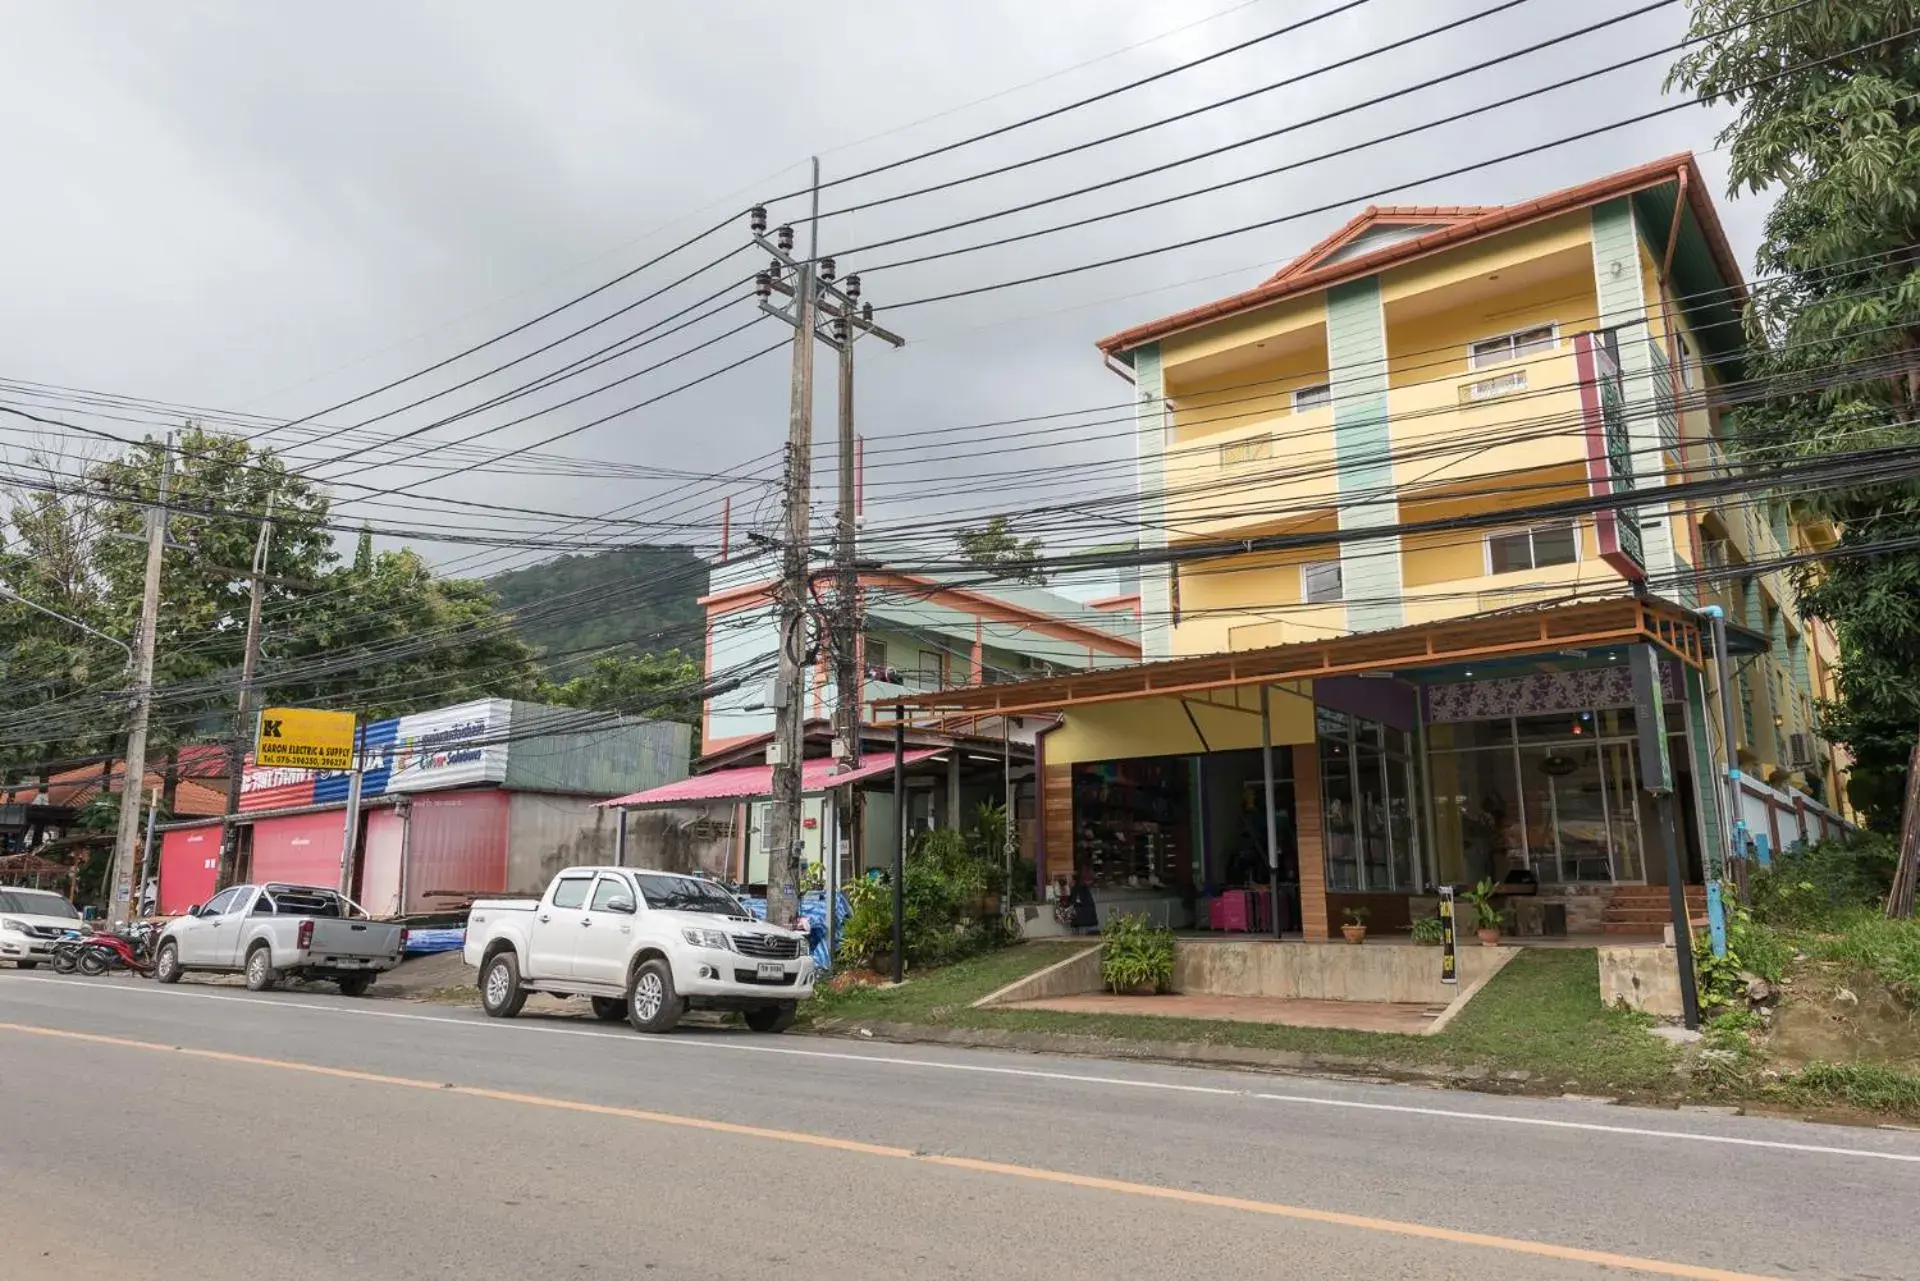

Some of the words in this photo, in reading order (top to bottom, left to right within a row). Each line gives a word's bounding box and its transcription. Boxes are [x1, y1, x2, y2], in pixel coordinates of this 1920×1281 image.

[263, 720, 282, 737] K
[262, 743, 288, 754] KARON
[289, 745, 317, 756] ELECTRIC
[319, 747, 324, 756] &
[326, 747, 350, 758] SUPPLY
